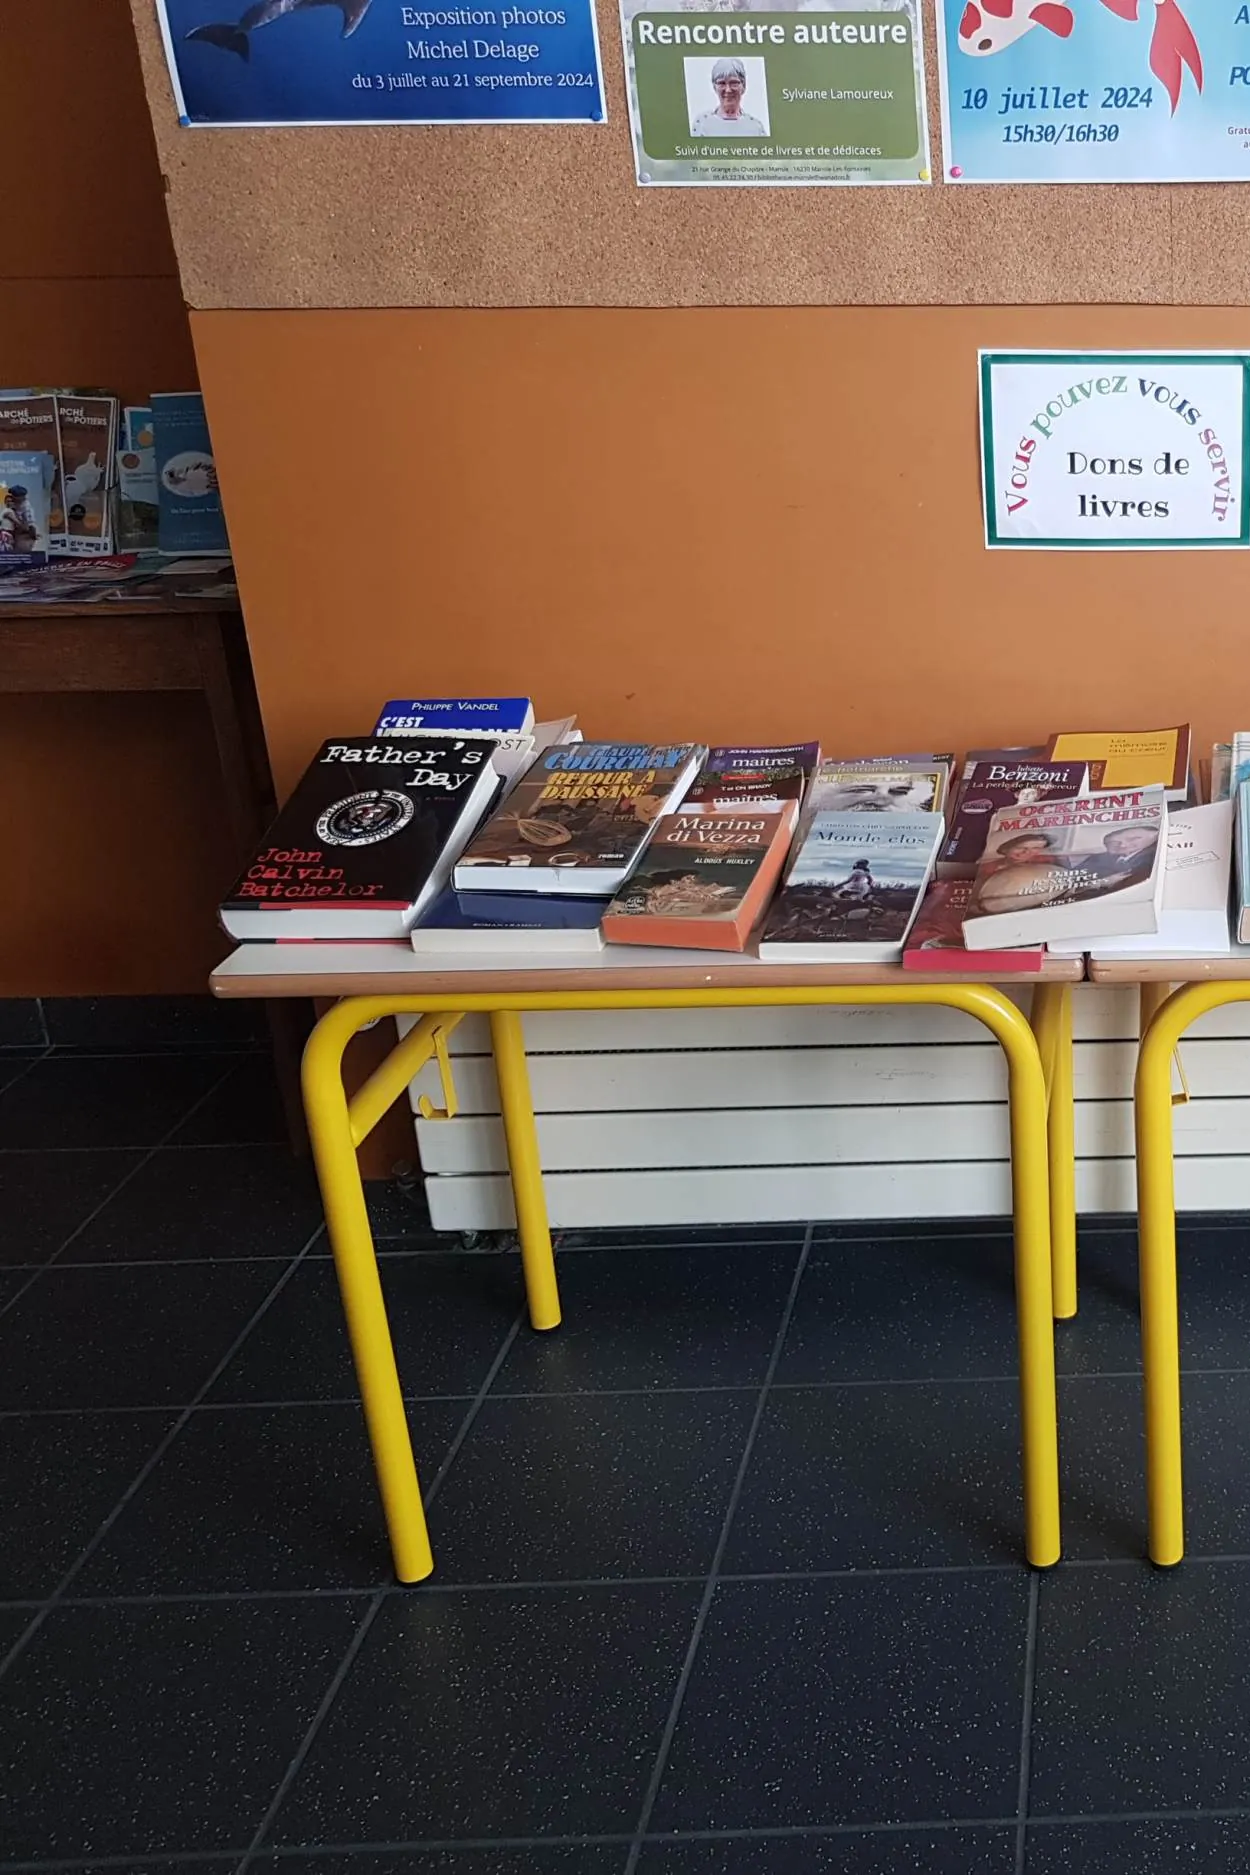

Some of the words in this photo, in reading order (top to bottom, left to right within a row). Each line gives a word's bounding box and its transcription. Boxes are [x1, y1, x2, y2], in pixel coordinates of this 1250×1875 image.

[401, 7, 496, 29] Exposition
[502, 9, 566, 29] photos
[638, 20, 786, 44] Rencontre
[794, 22, 907, 44] auteure
[406, 40, 468, 60] Michel
[473, 40, 540, 62] Delage
[352, 74, 372, 88] du
[376, 74, 384, 89] 3
[387, 72, 428, 91] juillet
[431, 76, 450, 88] au
[453, 73, 469, 88] 21
[474, 72, 552, 90] septembre
[556, 72, 594, 87] 2024
[782, 88, 828, 102] Sylviane
[830, 88, 894, 100] Lamoureux
[962, 88, 988, 110] 10
[998, 86, 1089, 114] juillet
[1100, 87, 1153, 110] 2024
[1002, 124, 1120, 146] 15h30/16h30
[675, 145, 698, 156] Suivi
[701, 145, 728, 156] d'une
[730, 146, 760, 156] vente
[762, 146, 774, 156] de
[776, 146, 802, 156] livres
[804, 146, 816, 156] et
[817, 146, 830, 156] de
[832, 145, 882, 156] dédicaces
[20, 415, 52, 424] POTIERS
[74, 417, 107, 425] POTIERS
[1004, 436, 1036, 516] Vous
[1030, 376, 1128, 440] pouvez
[1136, 378, 1202, 426] vous
[1198, 428, 1236, 522] servir
[1067, 452, 1143, 476] Dons
[1153, 452, 1190, 476] de
[1078, 494, 1170, 518] livres
[411, 702, 453, 711] PHILIPPE
[458, 702, 500, 711] VANDEL
[381, 717, 424, 728] C'EST
[320, 742, 484, 765] Father's
[732, 757, 795, 767] maîtres
[406, 768, 474, 790] Day
[548, 771, 633, 785] RETOUR
[987, 765, 1070, 782] Benzoni
[540, 784, 647, 799] DAUSSANE
[985, 782, 1010, 790] perle
[1019, 792, 1144, 817] OCKRENT
[674, 817, 766, 830] Marina
[999, 806, 1161, 832] MARENCHES
[666, 830, 691, 842] di
[698, 831, 761, 843] Vezza
[817, 831, 881, 843] Monde
[888, 834, 925, 844] clos
[257, 848, 322, 864] John
[248, 864, 343, 881] Calvin
[1047, 869, 1088, 878] Dans
[236, 882, 383, 897] Batchelor
